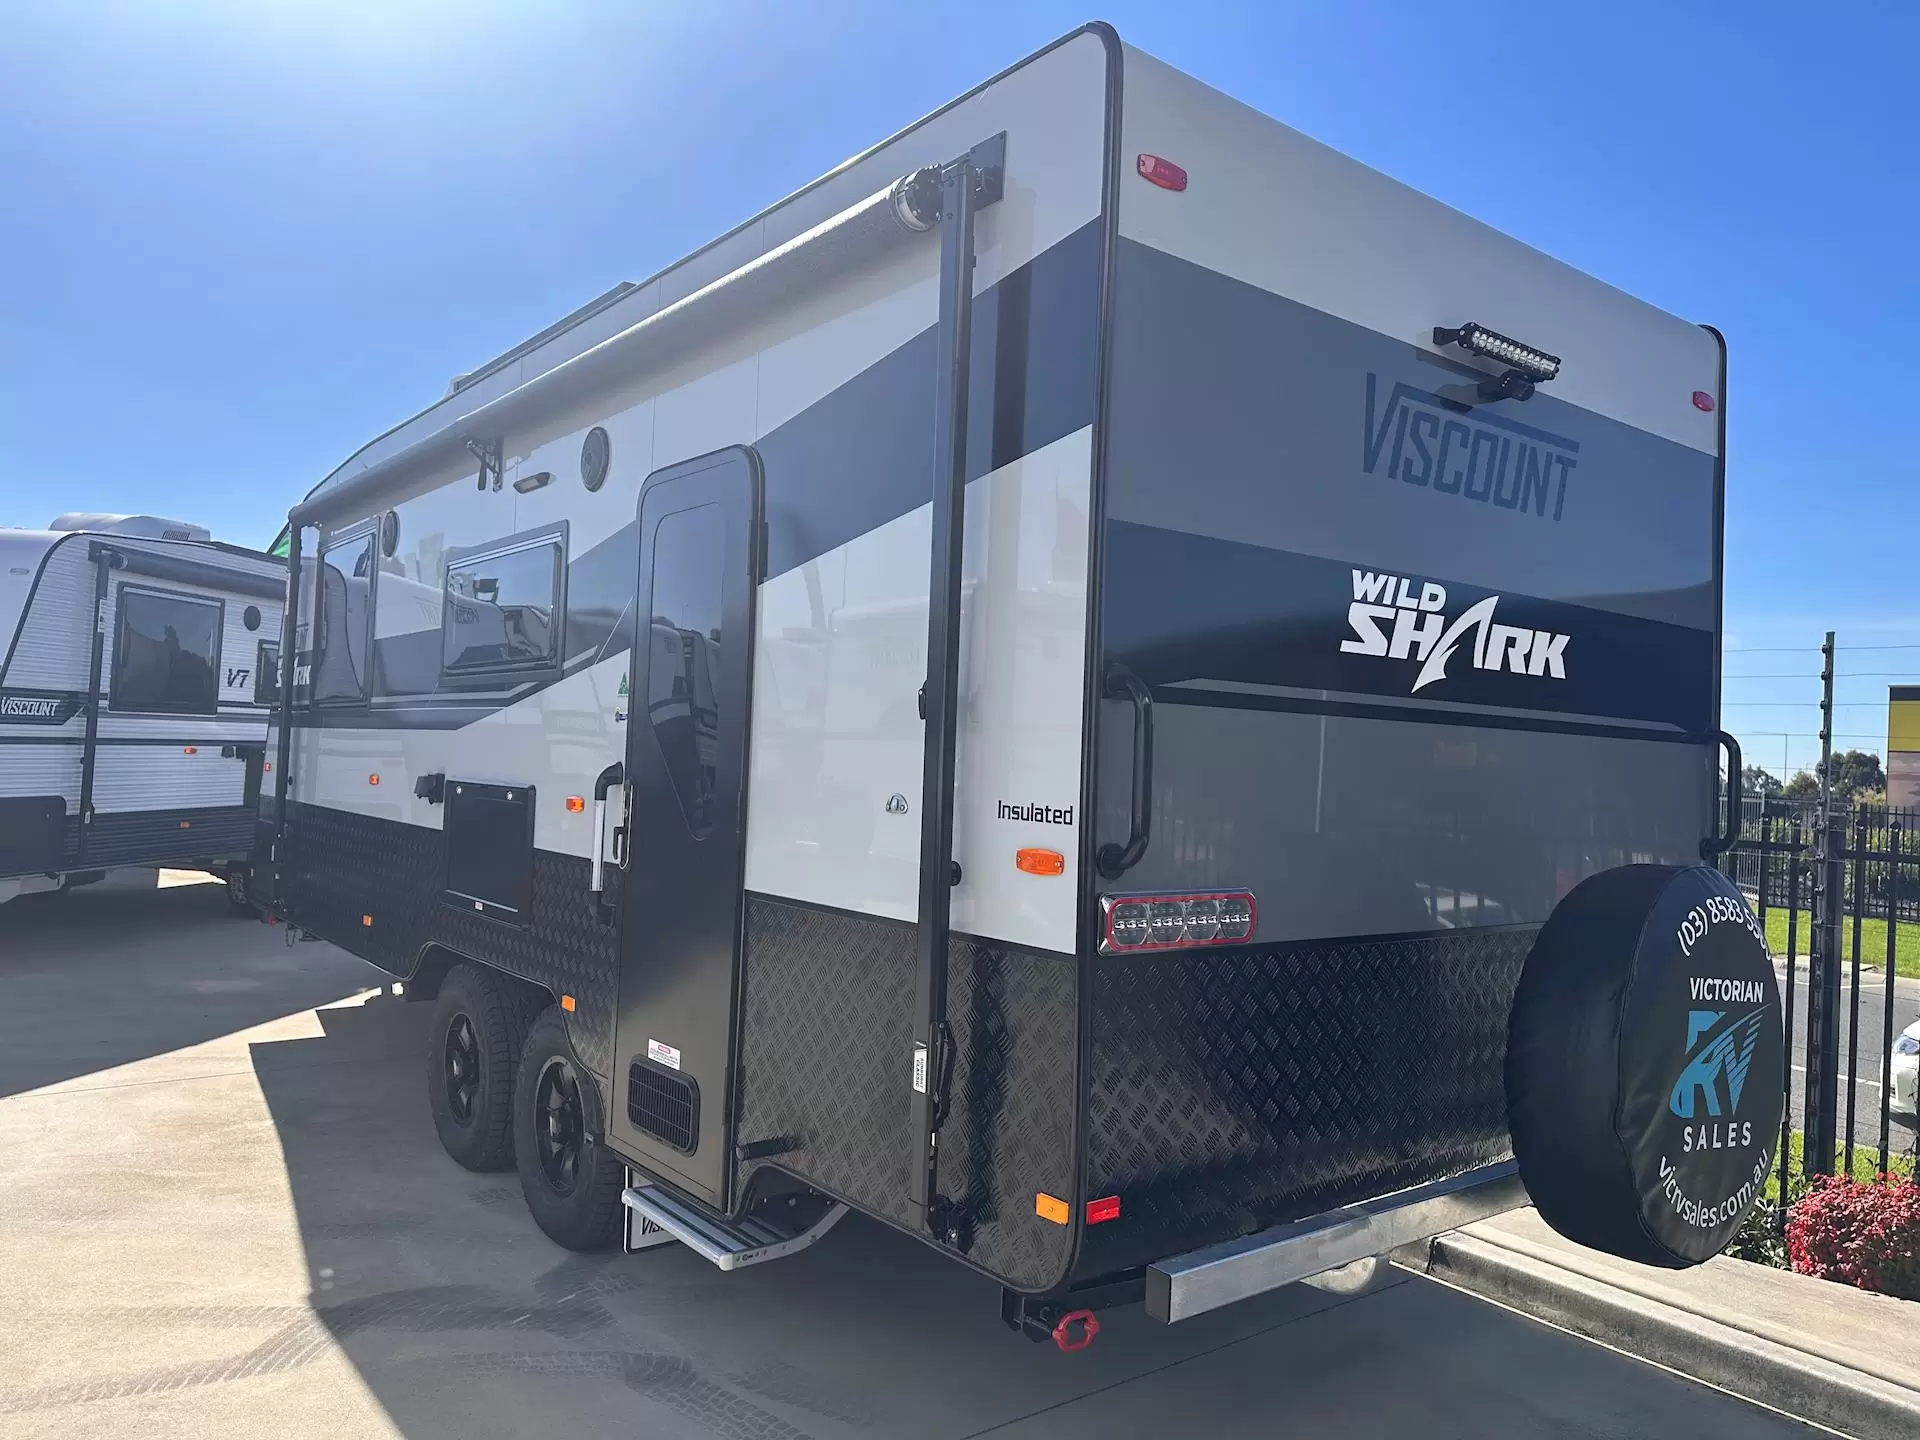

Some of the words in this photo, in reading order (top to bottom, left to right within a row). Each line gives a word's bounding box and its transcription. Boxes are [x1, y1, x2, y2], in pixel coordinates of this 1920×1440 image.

[1363, 371, 1580, 521] VISCOUNT
[1352, 568, 1447, 613] WILD
[1340, 595, 1571, 694] SHARK
[228, 668, 250, 688] V7
[1, 696, 61, 717] VISCOUNT
[997, 800, 1074, 826] Insulated
[1677, 905, 1708, 957] (03)
[1706, 896, 1744, 924] 8583
[1689, 976, 1764, 1004] VICTORIAN
[1683, 1121, 1752, 1153] SALES
[1659, 1147, 1769, 1228] vicrvsales.com.au
